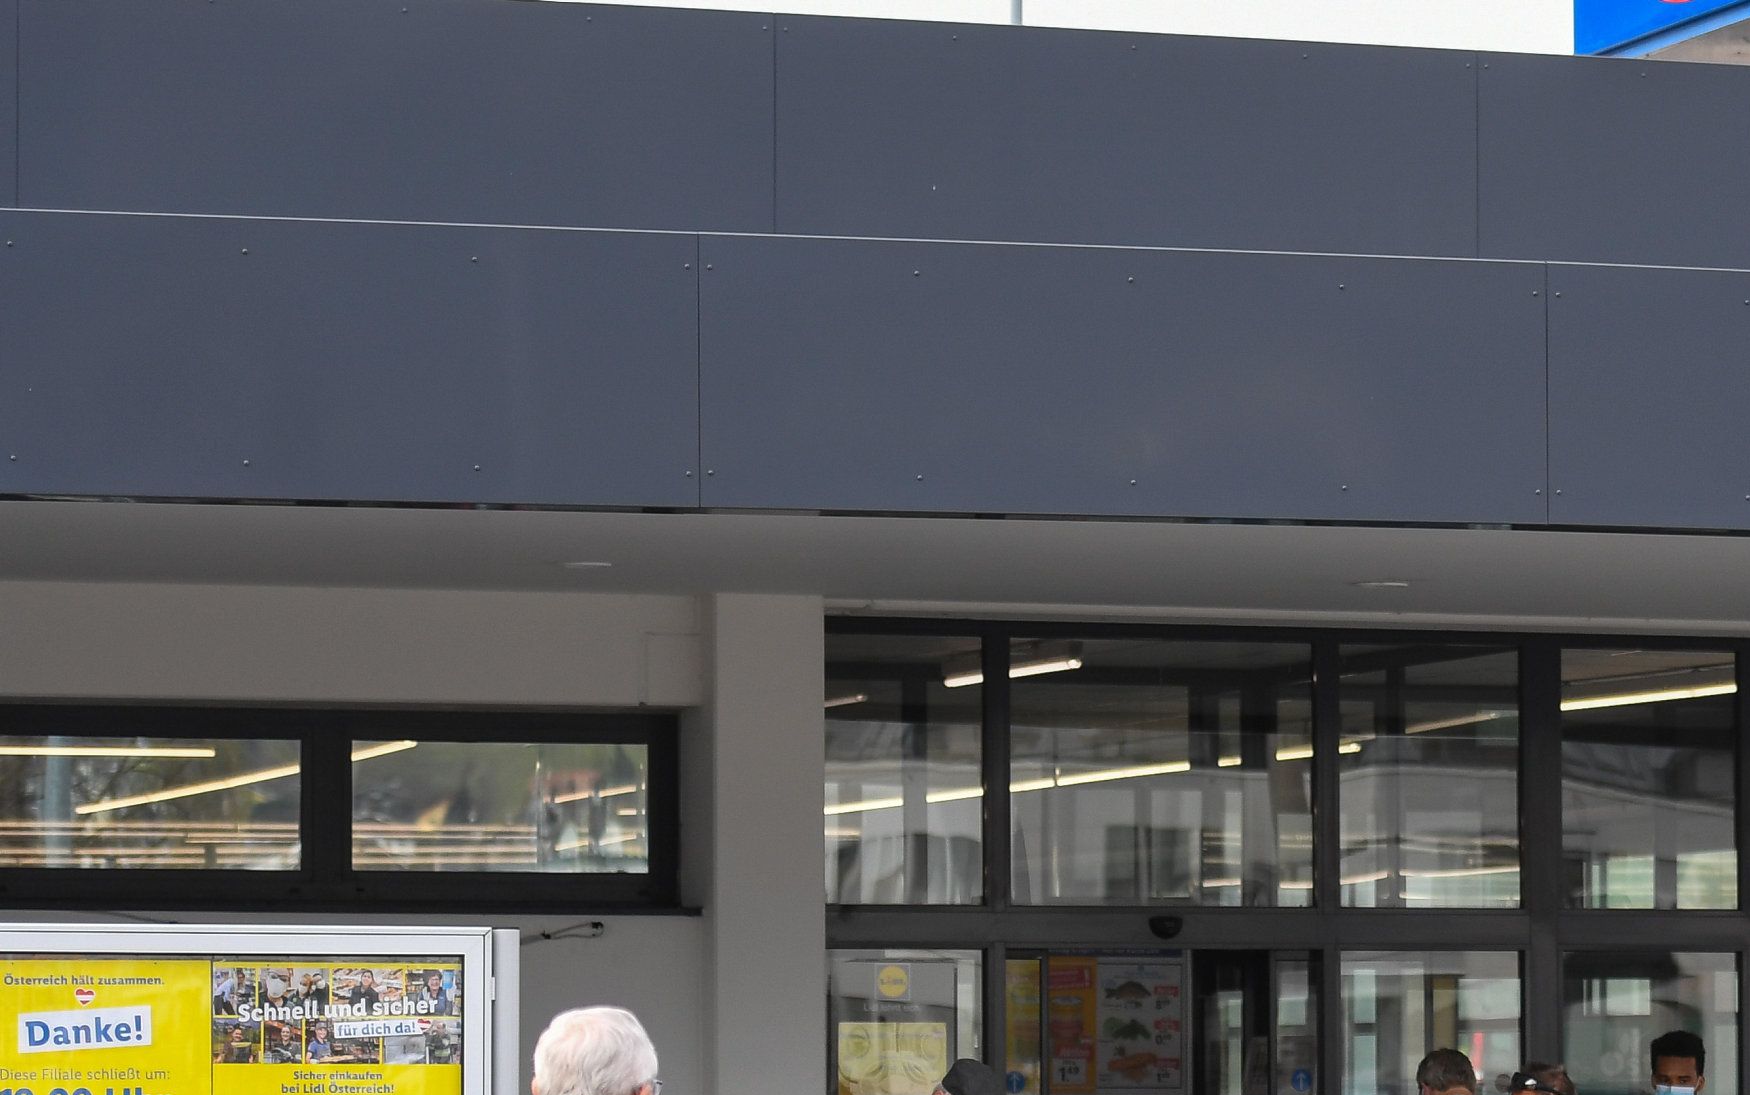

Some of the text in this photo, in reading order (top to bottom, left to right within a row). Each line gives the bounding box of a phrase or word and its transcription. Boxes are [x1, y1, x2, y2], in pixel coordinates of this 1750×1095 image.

[4, 973, 165, 986] Österreich hält zusammen.
[237, 996, 438, 1023] Schnell und sicher
[25, 1015, 143, 1047] Danke!
[337, 1021, 416, 1037] für dich da!
[0, 1068, 170, 1081] Diese Filiale schließt um:
[294, 1070, 383, 1080] Sicher einkaufen
[281, 1081, 395, 1094] bei Lidl Österreich!
